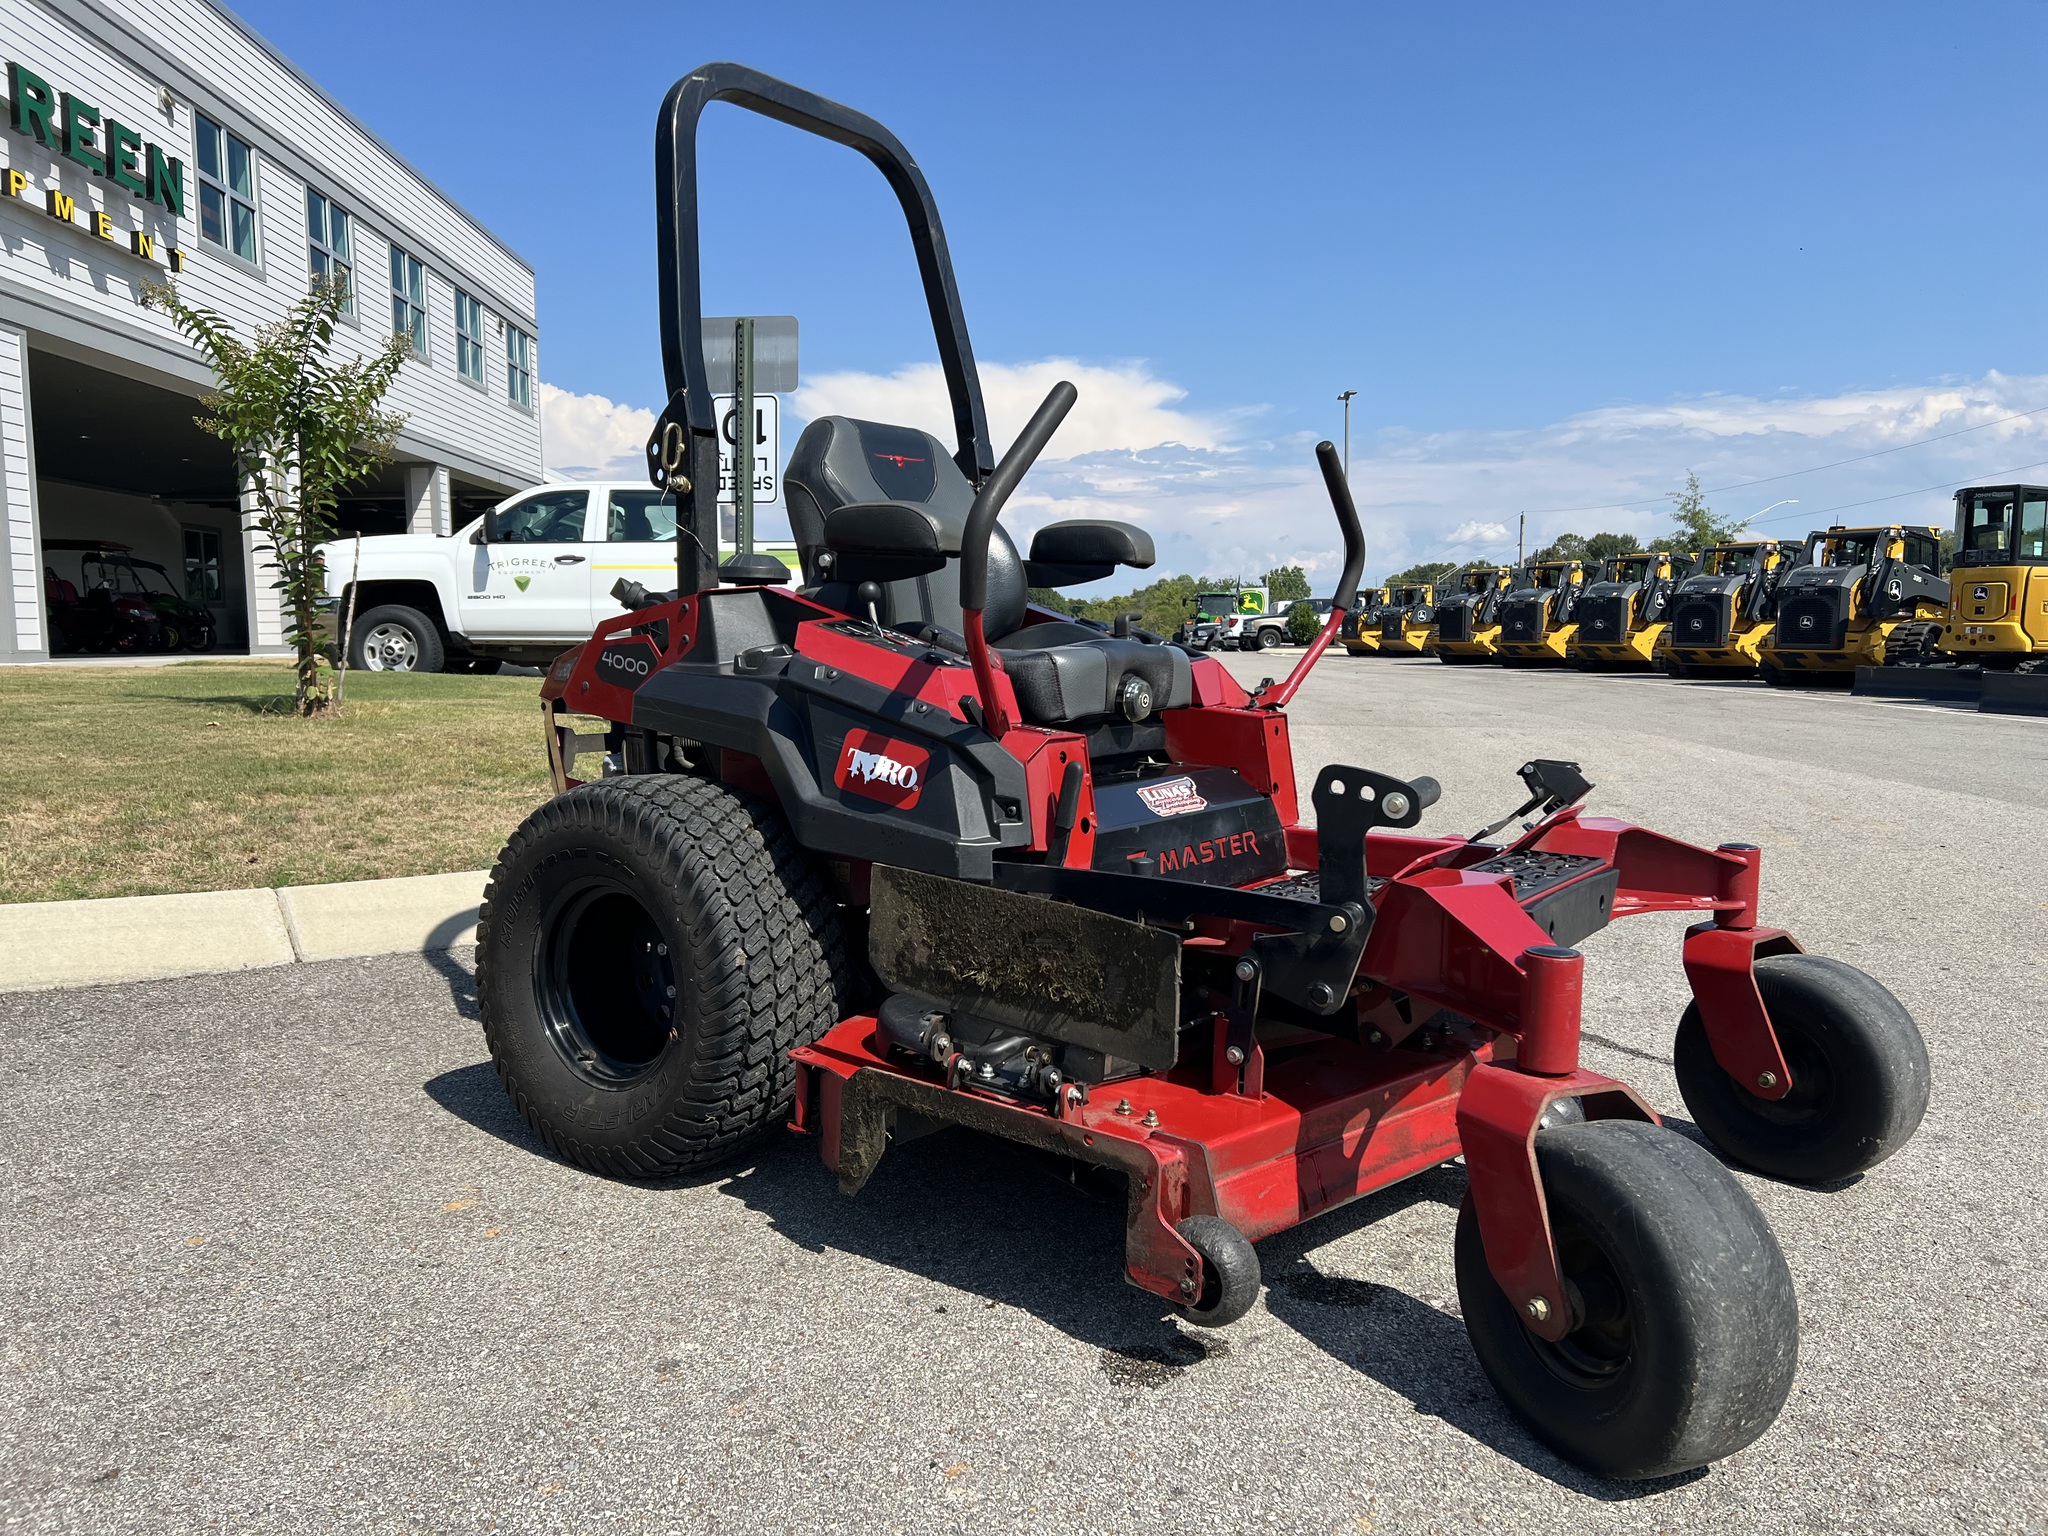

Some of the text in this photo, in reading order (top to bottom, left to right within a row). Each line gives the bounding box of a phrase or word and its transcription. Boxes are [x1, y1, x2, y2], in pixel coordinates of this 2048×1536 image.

[721, 457, 768, 472] LIIT
[601, 651, 649, 675] 4000
[847, 747, 918, 788] TORO
[1159, 830, 1261, 875] MASTER
